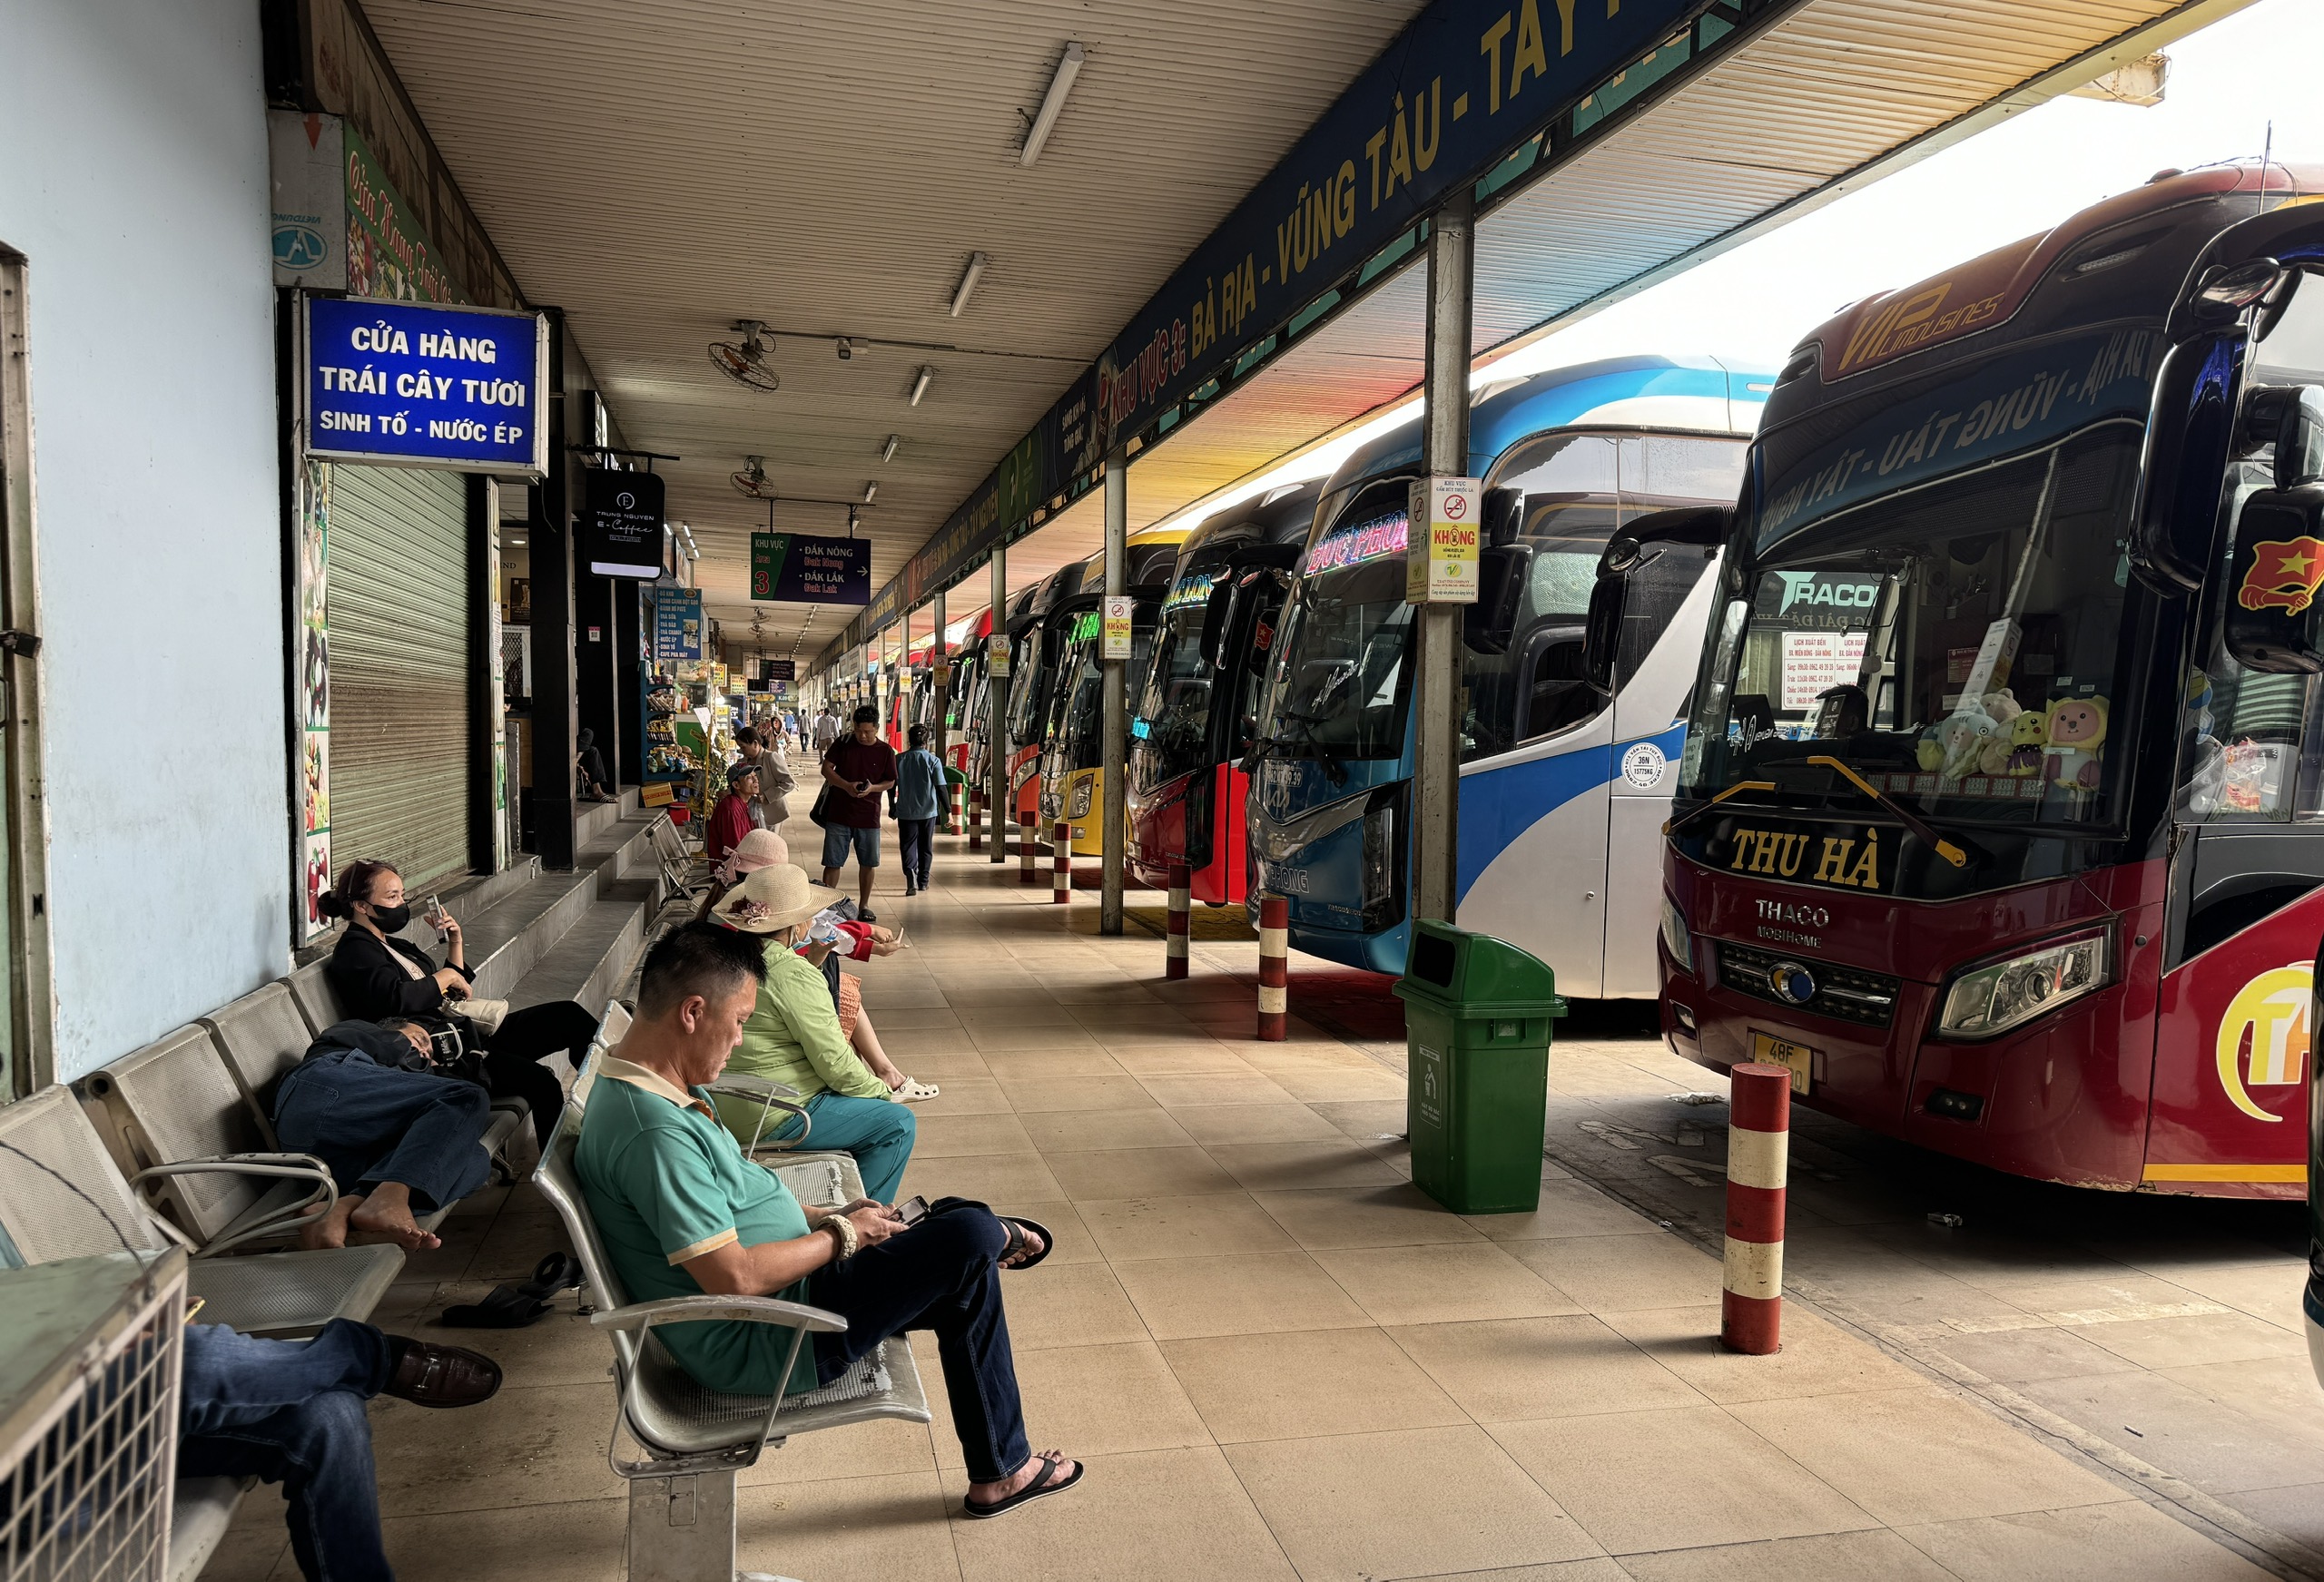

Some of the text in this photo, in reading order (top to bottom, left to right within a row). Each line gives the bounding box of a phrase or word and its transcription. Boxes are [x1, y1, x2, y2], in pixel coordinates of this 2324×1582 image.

[1110, 358, 1137, 427] KHU
[1139, 329, 1168, 405] VỰC
[1192, 276, 1216, 360] BÀ
[1221, 252, 1256, 337] RỊA
[1277, 159, 1355, 286] VŨNG
[1366, 75, 1442, 212] TÀU
[1837, 282, 2005, 371] VIP LIMOUSINES
[350, 319, 497, 364] CỬA HÀNG
[319, 364, 526, 408] TRÁI CÂY TƯƠI
[320, 410, 370, 433] SINH
[378, 410, 409, 436] TỐ
[429, 418, 487, 442] NƯỚC
[494, 421, 524, 445] ÉP
[596, 510, 621, 518] TRUNG
[754, 538, 784, 551] KHU VỰC
[804, 543, 853, 557] ĐẮK NÔNG
[754, 554, 770, 564] Area
[822, 559, 844, 570] Nong
[754, 571, 770, 594] 3
[804, 569, 845, 584] ĐẮK LẮK
[822, 584, 837, 594] Lak
[1774, 571, 1879, 618] TRACO
[1730, 827, 1880, 889] THU HÀ
[1755, 899, 1830, 929] THACO
[1757, 925, 1823, 949] MOBIHOME
[1768, 1041, 1794, 1065] 48F
